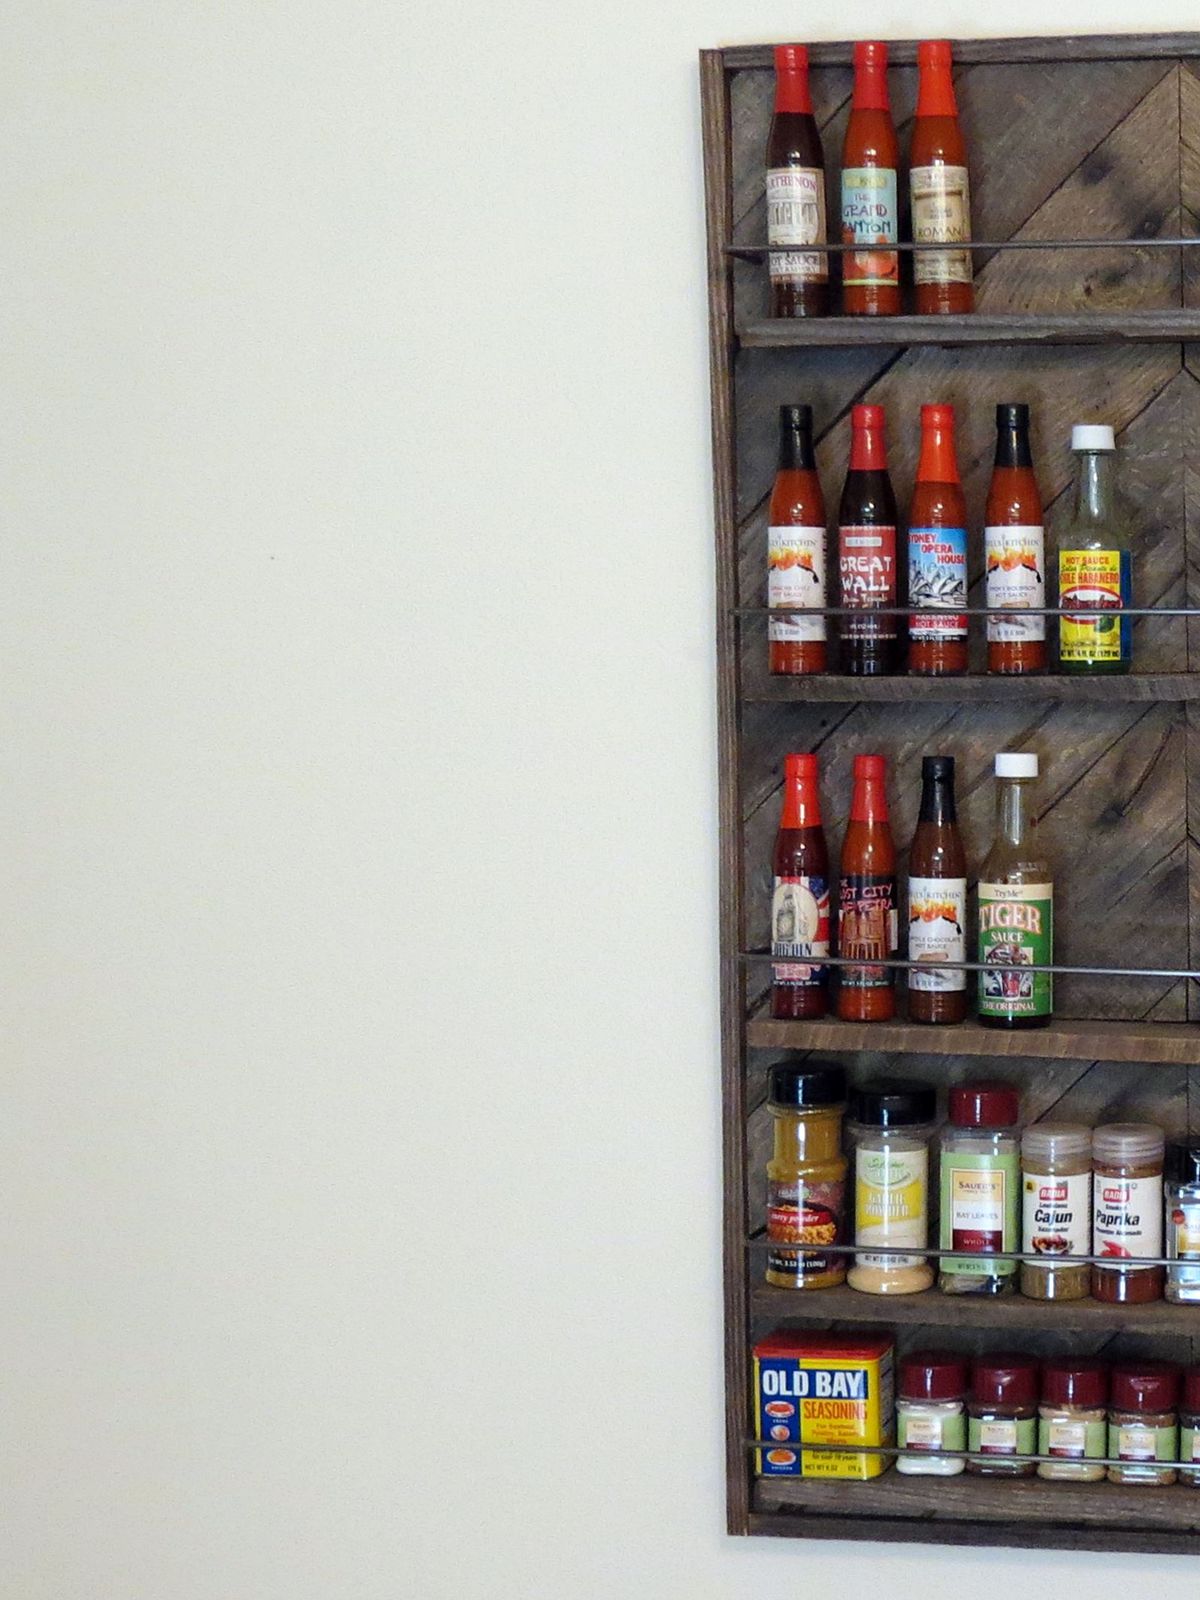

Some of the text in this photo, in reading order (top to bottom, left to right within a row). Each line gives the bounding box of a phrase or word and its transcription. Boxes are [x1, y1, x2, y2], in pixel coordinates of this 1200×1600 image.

[843, 204, 888, 217] GRAND
[921, 544, 954, 554] OPERA
[840, 556, 892, 573] GREAT
[1066, 556, 1110, 565] HOT SAUCE
[842, 573, 890, 594] WALL
[862, 883, 893, 899] CITY
[979, 902, 1042, 935] TIGER
[991, 932, 1025, 943] SAUCE
[995, 1002, 1037, 1011] ORIGINAL
[1040, 1189, 1066, 1199] BADIA
[1034, 1209, 1073, 1225] Cajun
[1096, 1210, 1141, 1227] Paprika
[763, 1370, 866, 1398] OLD BAY
[803, 1401, 868, 1420] SEASONING
